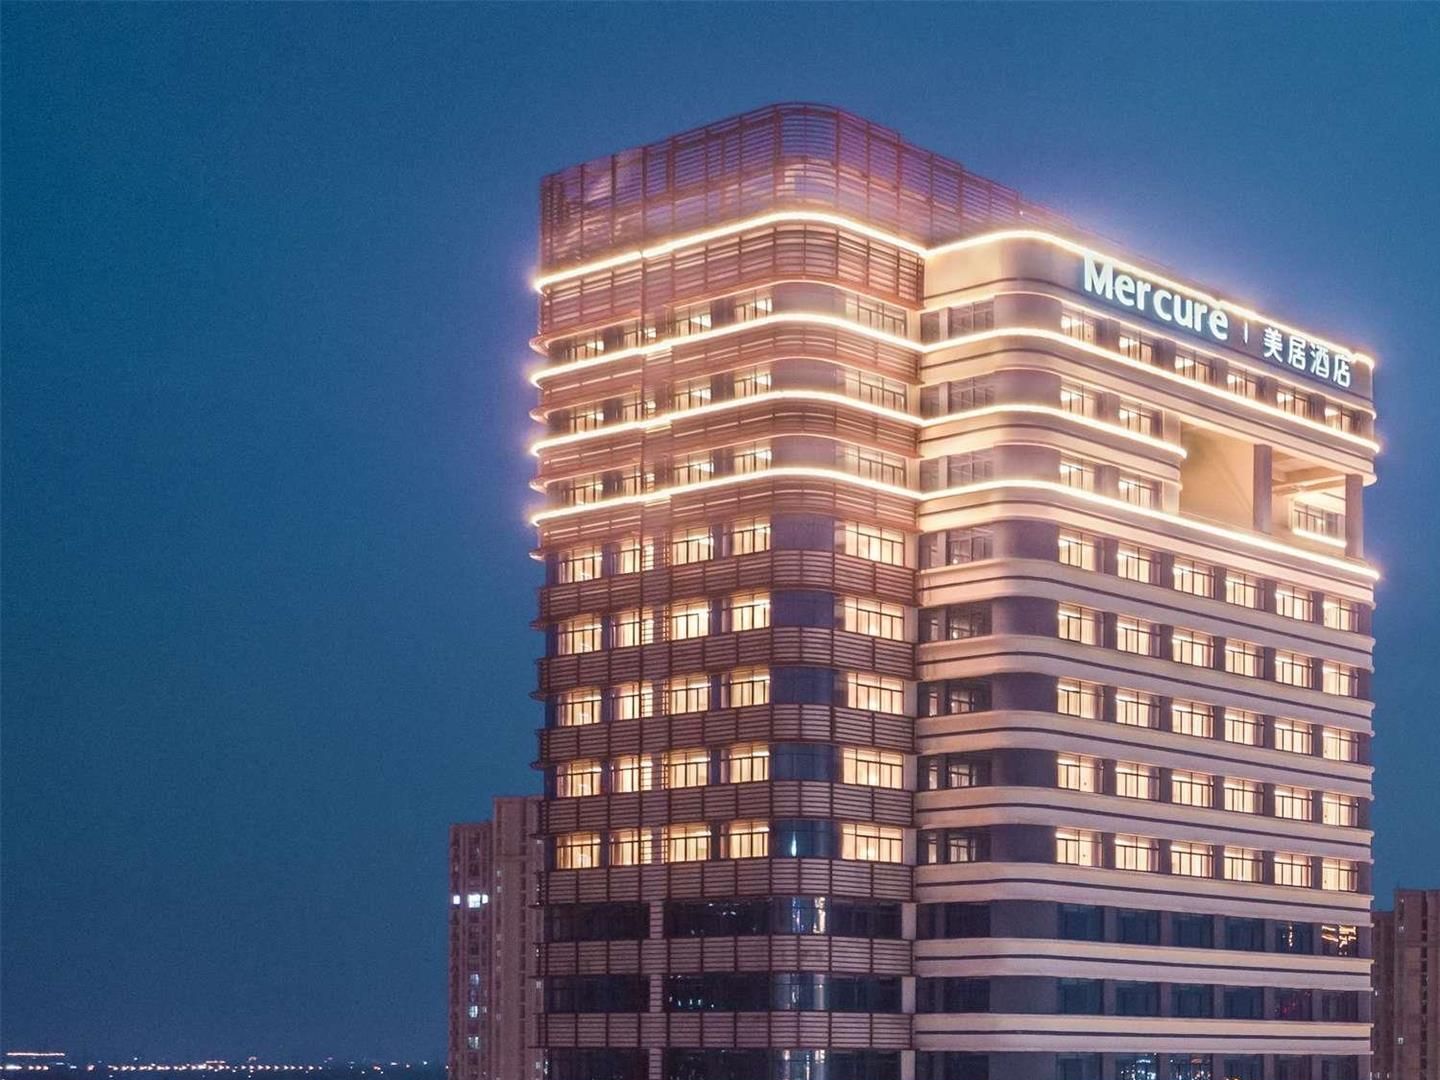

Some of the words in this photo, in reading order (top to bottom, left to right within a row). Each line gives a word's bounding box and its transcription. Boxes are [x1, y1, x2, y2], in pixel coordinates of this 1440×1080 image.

[1084, 253, 1229, 341] Mercure
[1263, 327, 1351, 388] 美居酒店
